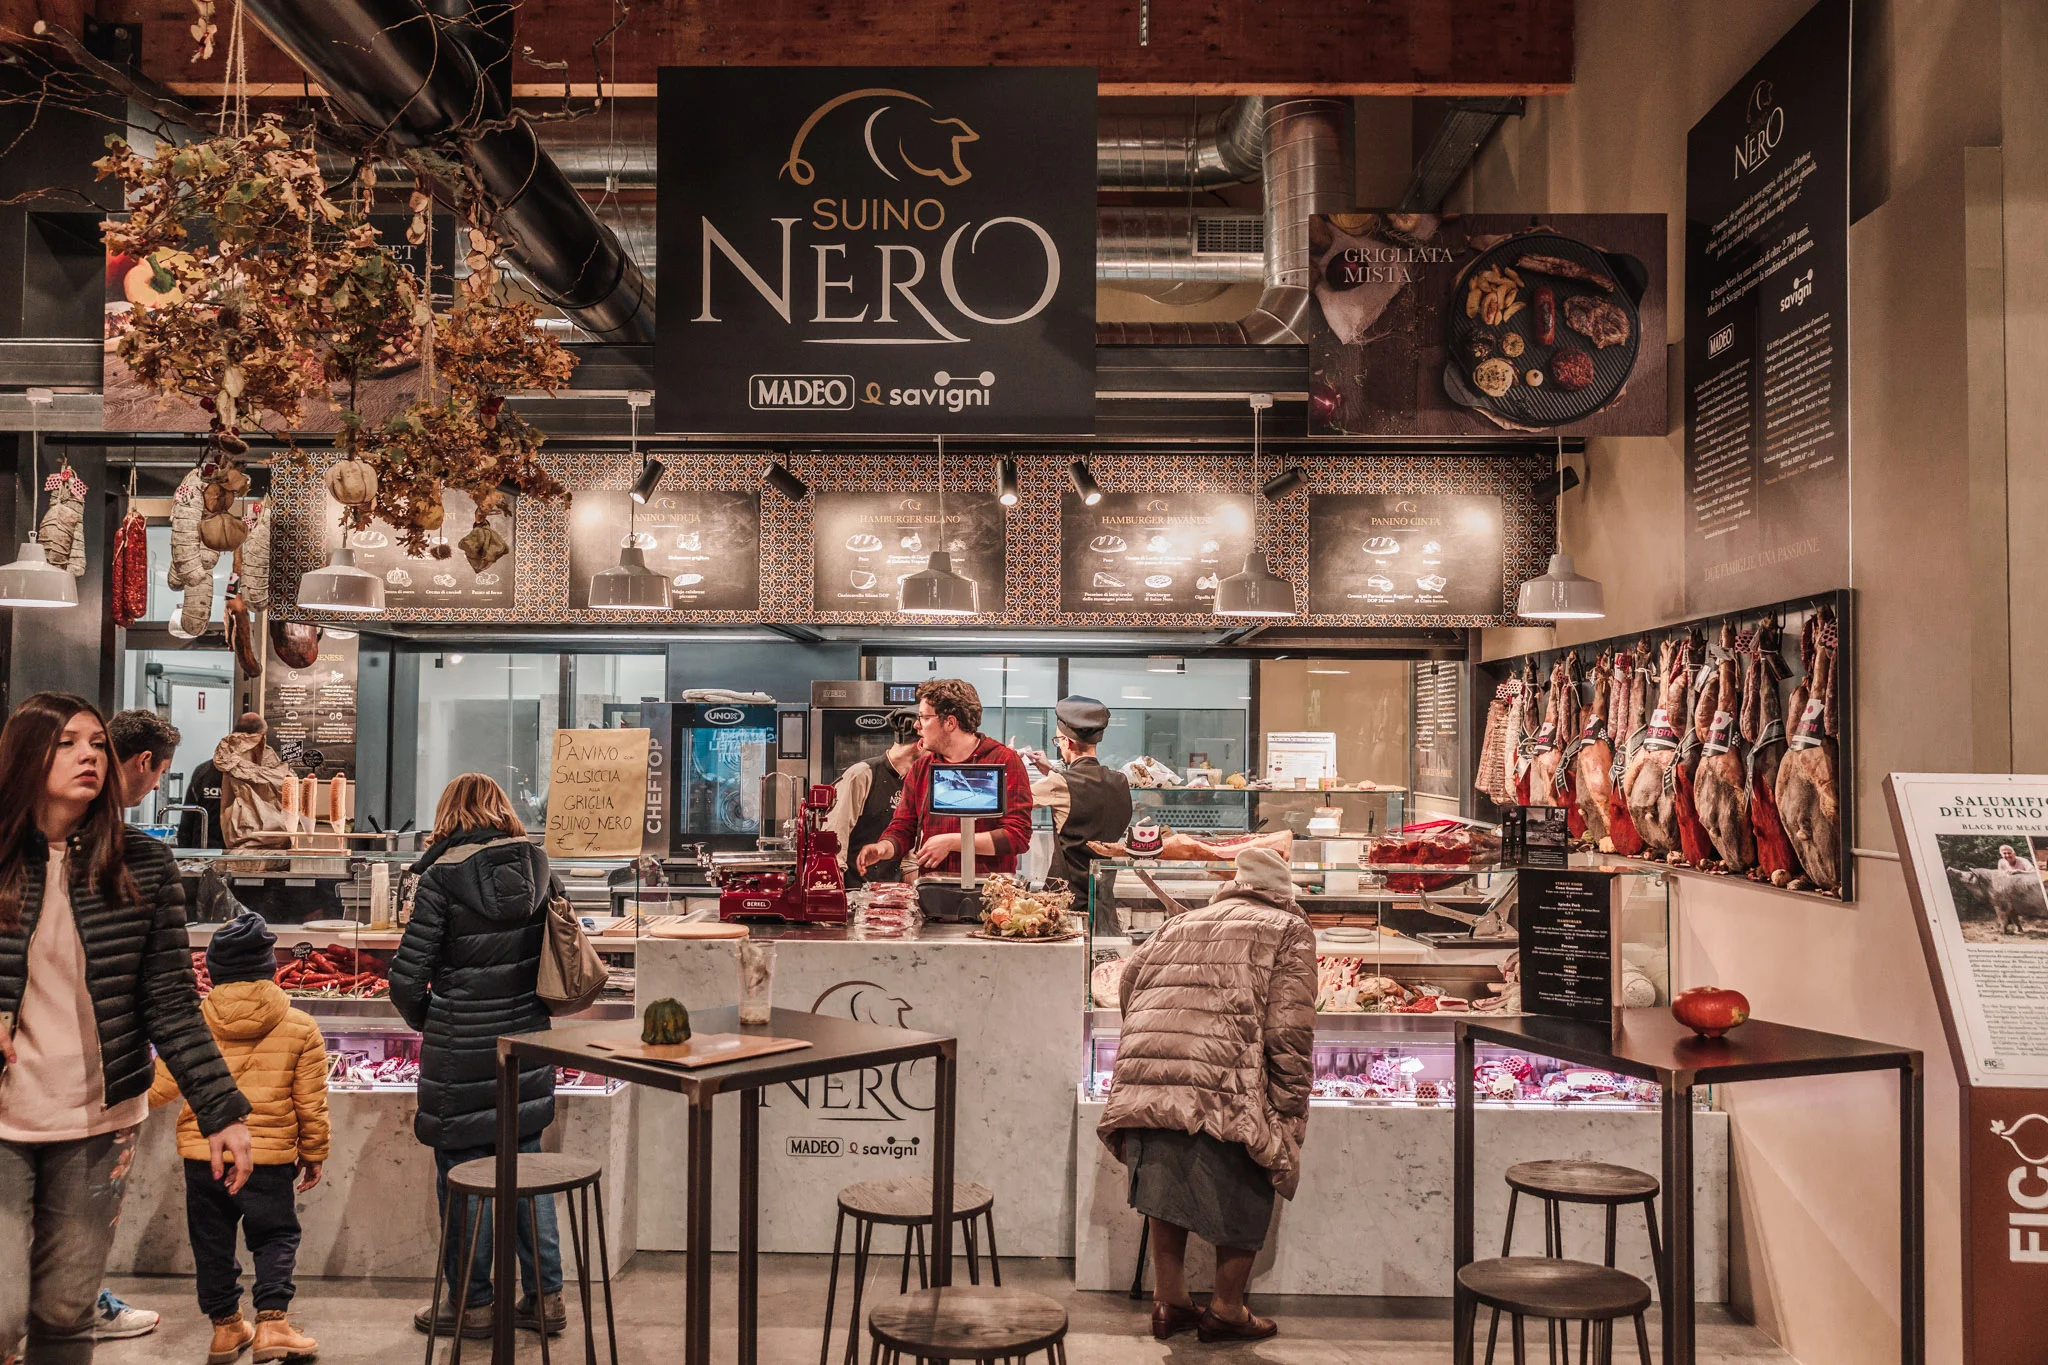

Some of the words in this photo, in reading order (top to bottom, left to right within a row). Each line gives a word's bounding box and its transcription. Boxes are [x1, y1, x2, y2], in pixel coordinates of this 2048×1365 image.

[1735, 106, 1784, 180] NERO
[813, 198, 945, 231] SUINO
[1344, 248, 1454, 263] GRIGLIATA
[691, 216, 1060, 345] NERO
[1344, 267, 1412, 283] MISTA
[1780, 268, 1813, 312] savigni
[1710, 328, 1732, 354] MADEO
[758, 380, 847, 406] MADEO
[890, 371, 995, 413] savigni
[860, 515, 922, 523] HAMBURGER
[924, 515, 960, 523] SILANO
[1102, 516, 1164, 524] HAMBURGER
[1371, 517, 1408, 526] PANINO
[1410, 517, 1441, 526] CINTA
[708, 712, 738, 720] UNOX
[557, 733, 619, 761] PANINO
[555, 765, 621, 784] SALSICCIA
[647, 738, 663, 834] CHEFTOP
[563, 795, 614, 810] GRIGLIA
[1939, 807, 1977, 817] DEL
[1983, 808, 2042, 818] SUINO
[549, 815, 590, 831] SUINO
[598, 816, 632, 830] NERO
[791, 1140, 839, 1154] MADEO
[862, 1137, 920, 1159] savigni
